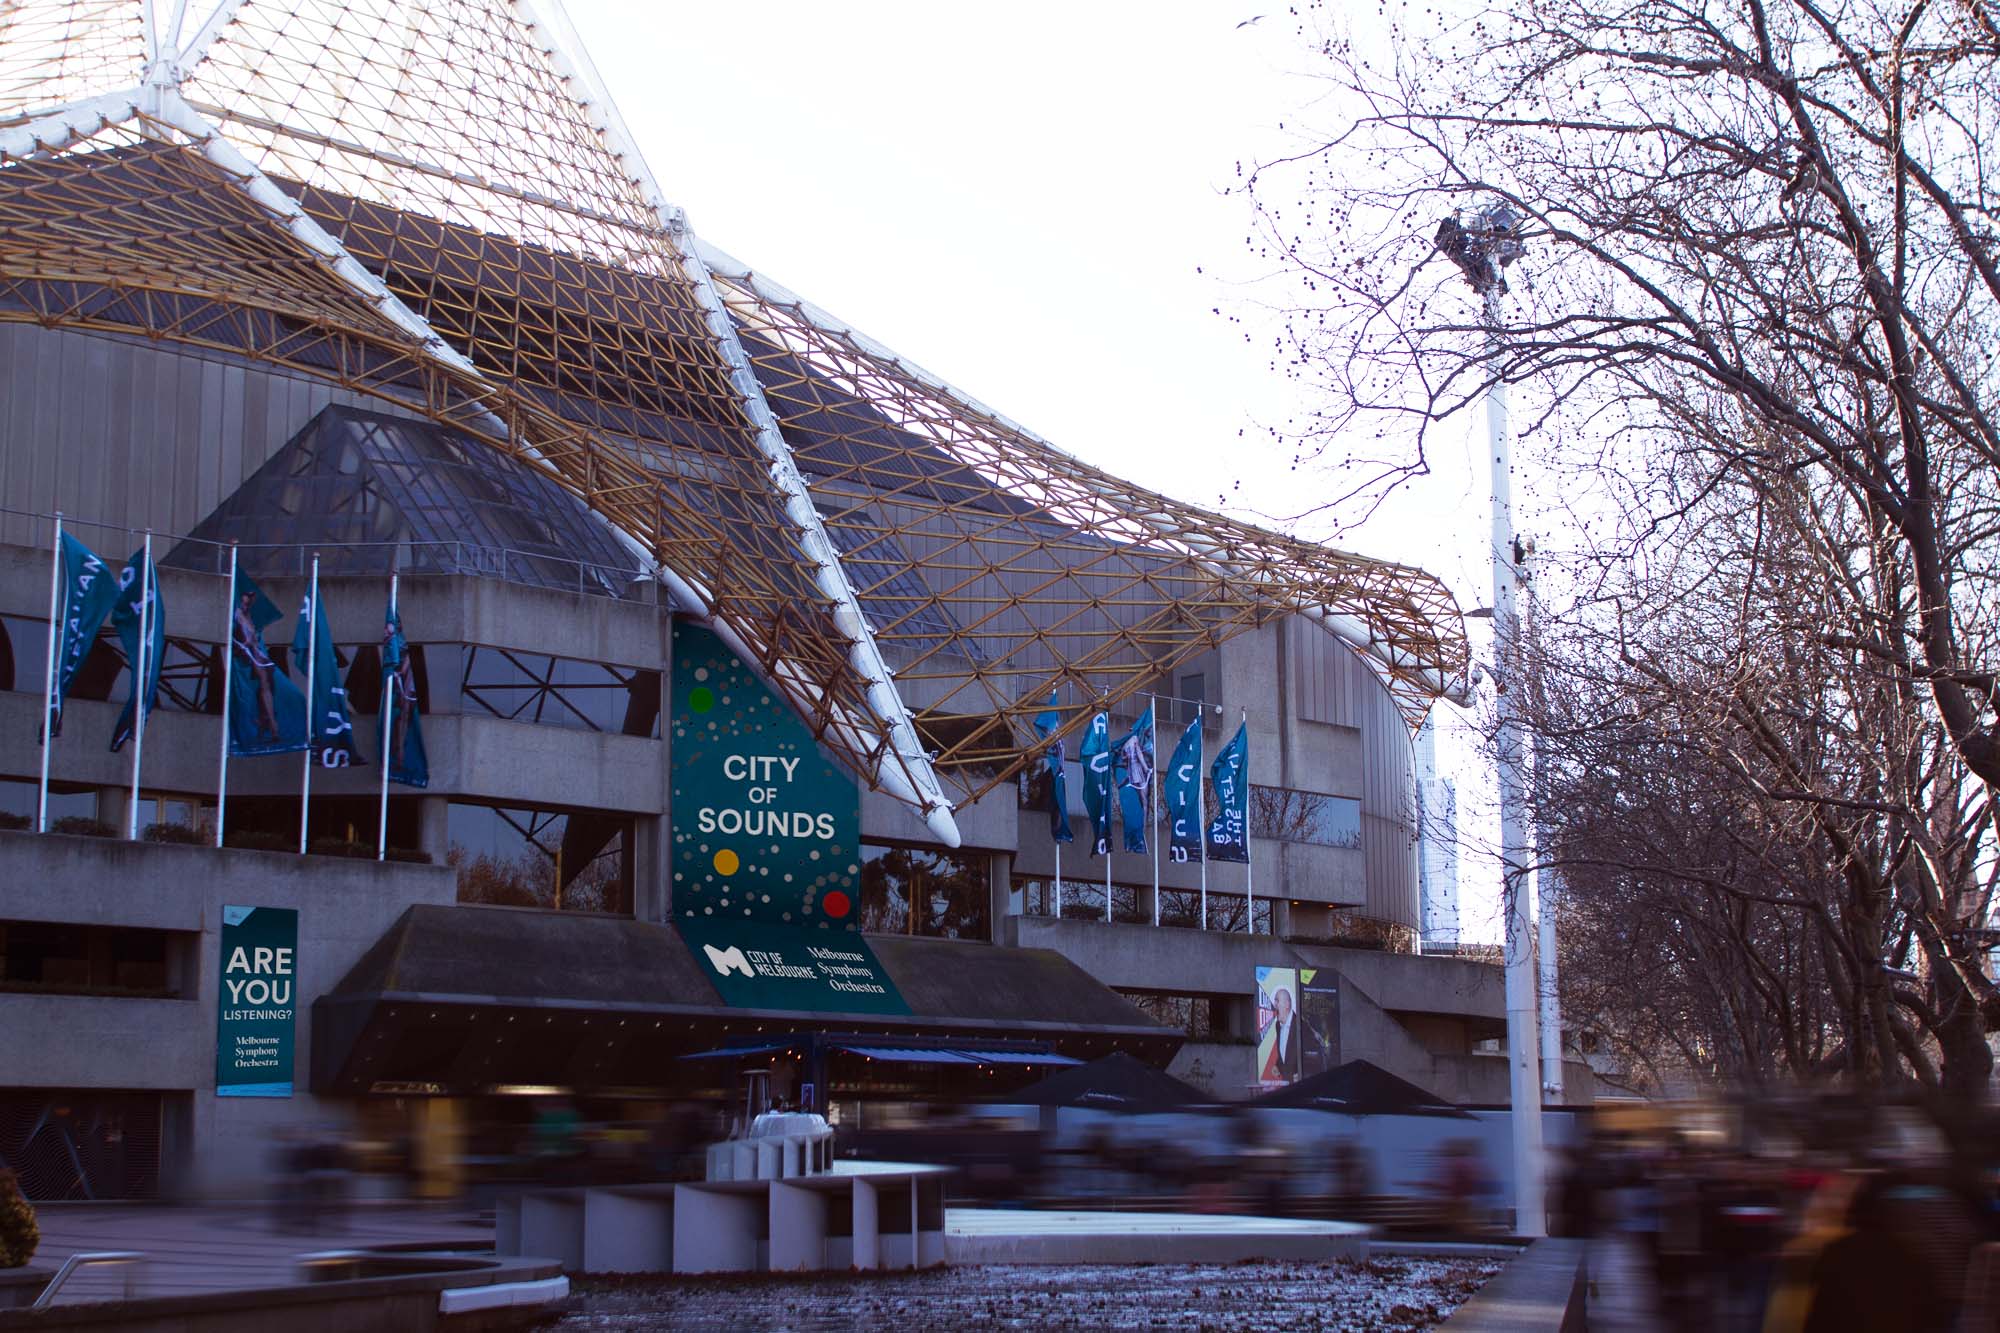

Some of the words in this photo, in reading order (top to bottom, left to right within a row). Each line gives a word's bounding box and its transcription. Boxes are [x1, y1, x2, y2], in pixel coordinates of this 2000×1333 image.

[723, 754, 801, 783] CITY
[748, 786, 778, 804] OF
[697, 807, 836, 840] SOUNDS
[226, 946, 293, 975] ARE
[746, 950, 771, 964] CITY
[770, 952, 784, 964] OF
[806, 946, 865, 962] Melbourne
[754, 963, 818, 980] MELBOURNE
[817, 961, 873, 980] Symphony
[226, 979, 291, 1005] YOU
[829, 979, 886, 994] Orchestra
[224, 1009, 293, 1021] LISTENING?
[236, 1036, 280, 1045] Melbourne
[235, 1047, 279, 1057] Symphony
[235, 1059, 279, 1068] Orchestra
